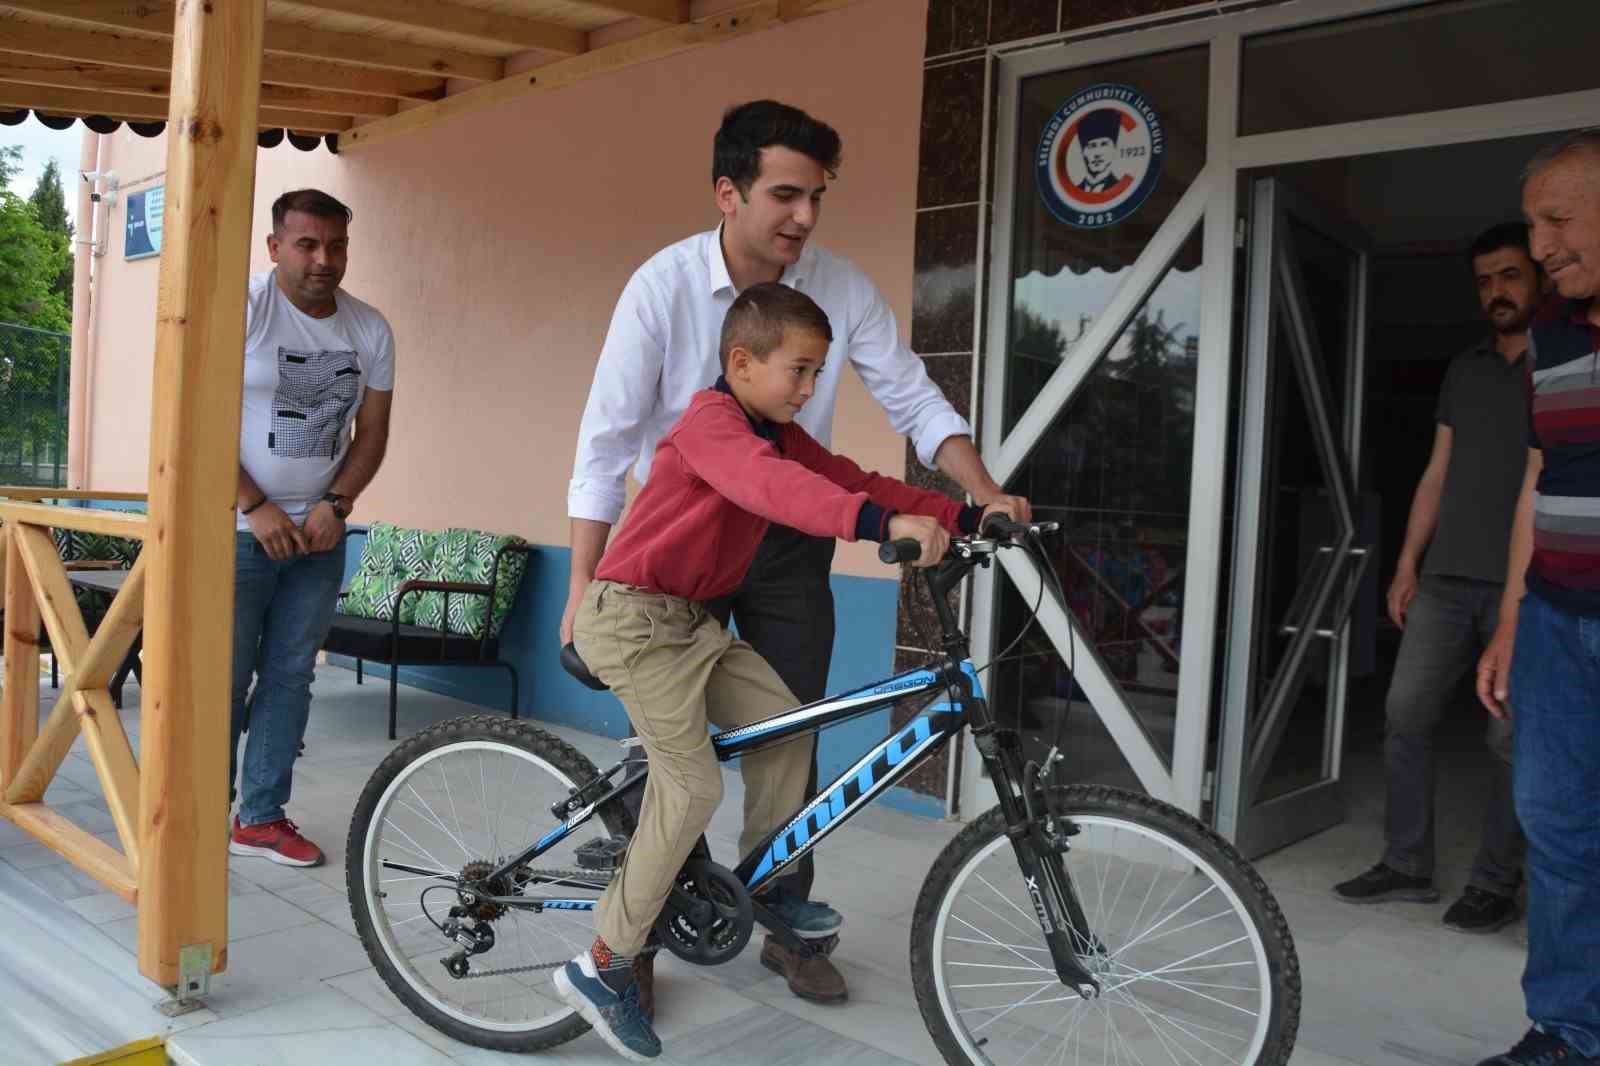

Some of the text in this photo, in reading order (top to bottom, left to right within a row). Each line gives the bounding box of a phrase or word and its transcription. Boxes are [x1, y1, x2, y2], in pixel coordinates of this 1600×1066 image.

[1063, 88, 1134, 115] CUMHURİYET
[1135, 98, 1163, 155] İLKOKULU
[1078, 212, 1113, 225] 2002
